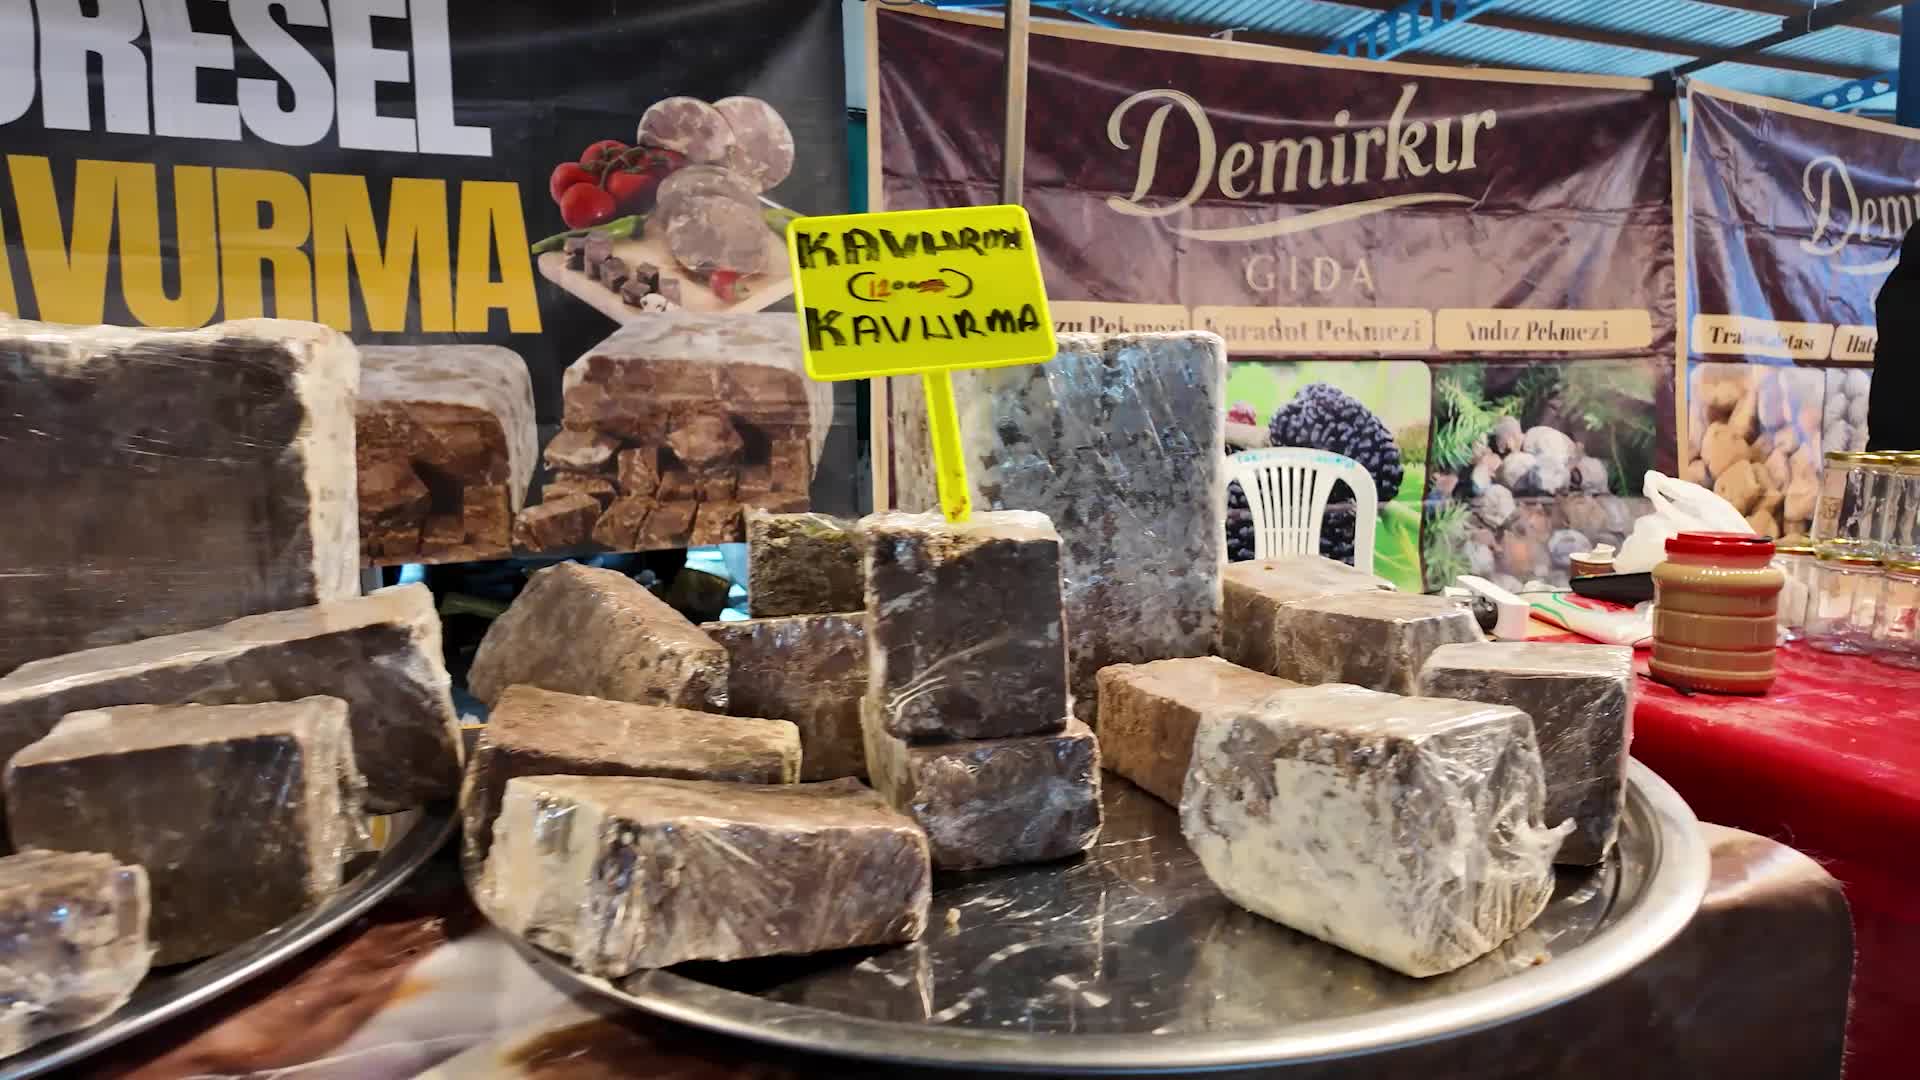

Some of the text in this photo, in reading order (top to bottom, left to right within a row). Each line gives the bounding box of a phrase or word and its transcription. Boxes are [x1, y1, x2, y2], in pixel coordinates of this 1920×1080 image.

[0, 154, 543, 333] VURMA
[1246, 255, 1376, 292] GIDA
[1527, 319, 1609, 342] Pekmezi
